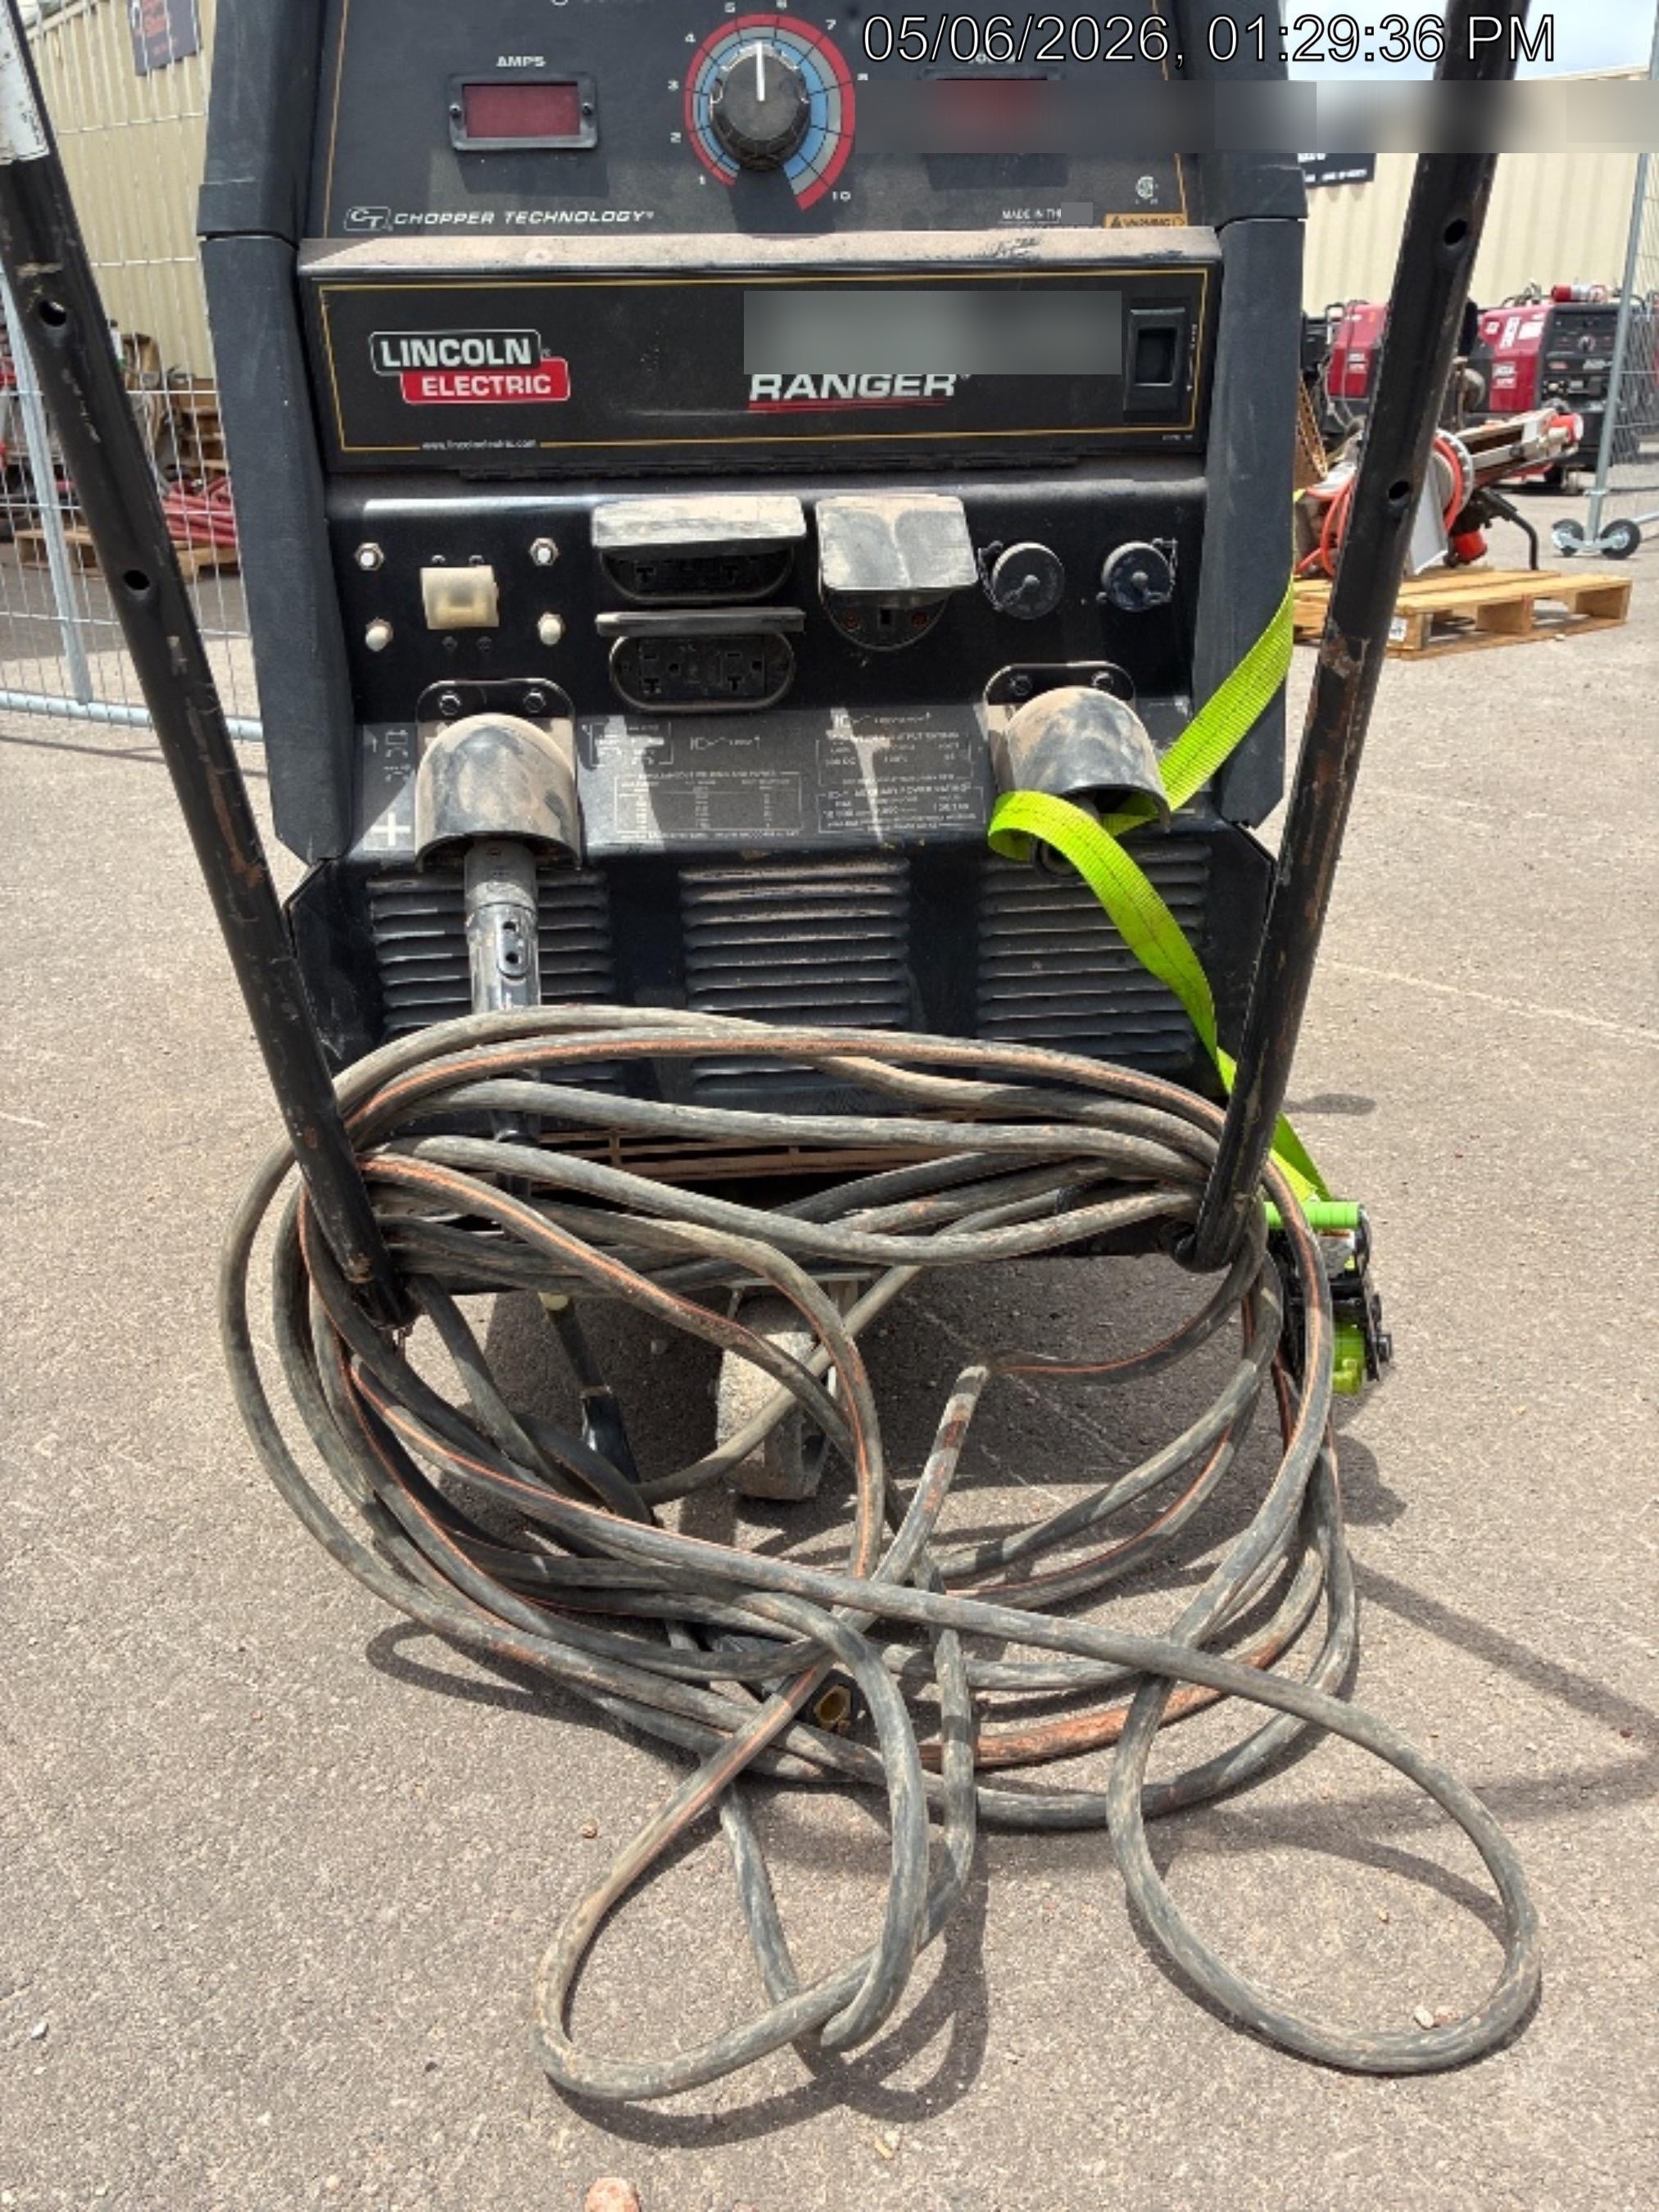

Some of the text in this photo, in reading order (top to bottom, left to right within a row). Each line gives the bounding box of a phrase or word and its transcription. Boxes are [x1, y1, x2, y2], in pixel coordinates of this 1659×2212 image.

[724, 2, 736, 13] 5
[826, 19, 836, 30] 7
[685, 33, 696, 43] 4
[496, 55, 546, 67] AMPS
[668, 79, 679, 91] 3
[670, 131, 682, 143] 2
[698, 175, 706, 185] 1
[832, 191, 851, 202] 10
[393, 212, 495, 225] CHOPPER
[379, 338, 533, 368] LINCOLN
[421, 374, 552, 397] ELECTRIC
[749, 374, 957, 401] RANGER
